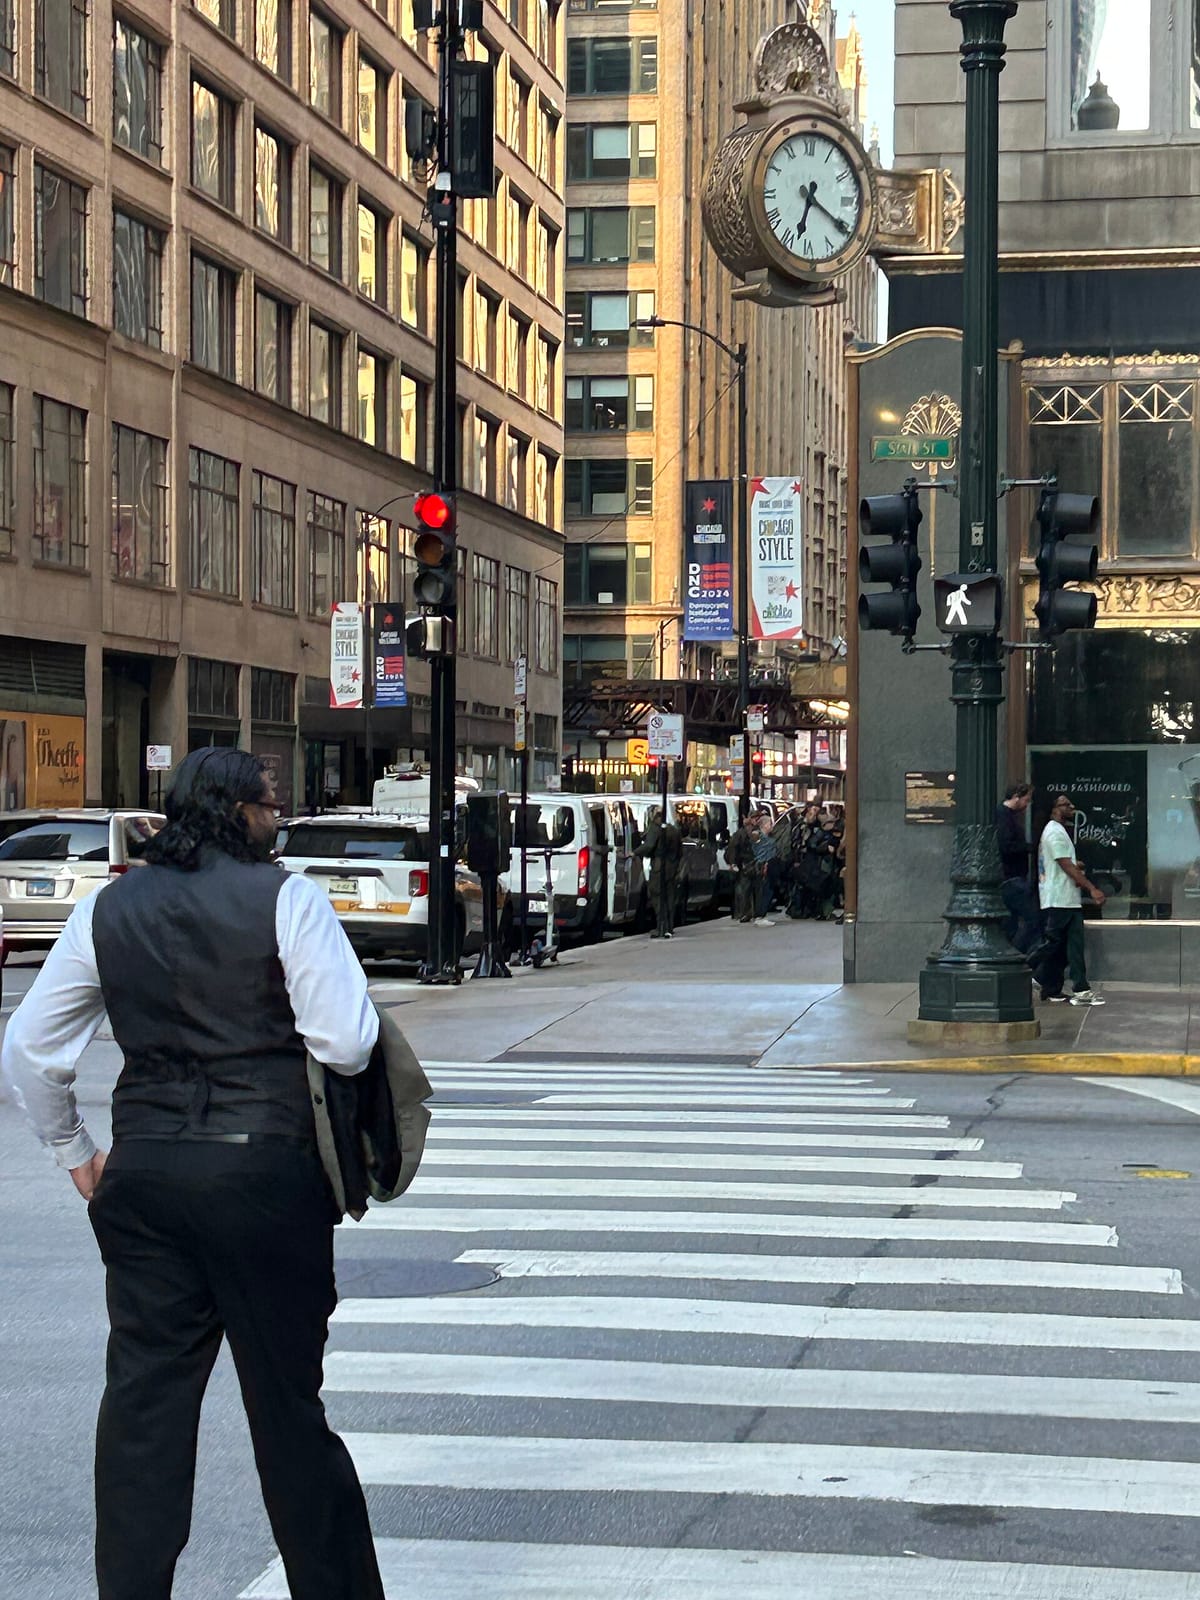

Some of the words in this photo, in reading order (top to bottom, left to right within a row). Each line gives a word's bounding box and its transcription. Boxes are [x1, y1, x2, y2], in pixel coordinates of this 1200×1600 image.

[758, 537, 794, 562] STYLE
[688, 563, 701, 598] DNC
[335, 640, 359, 657] STYLE
